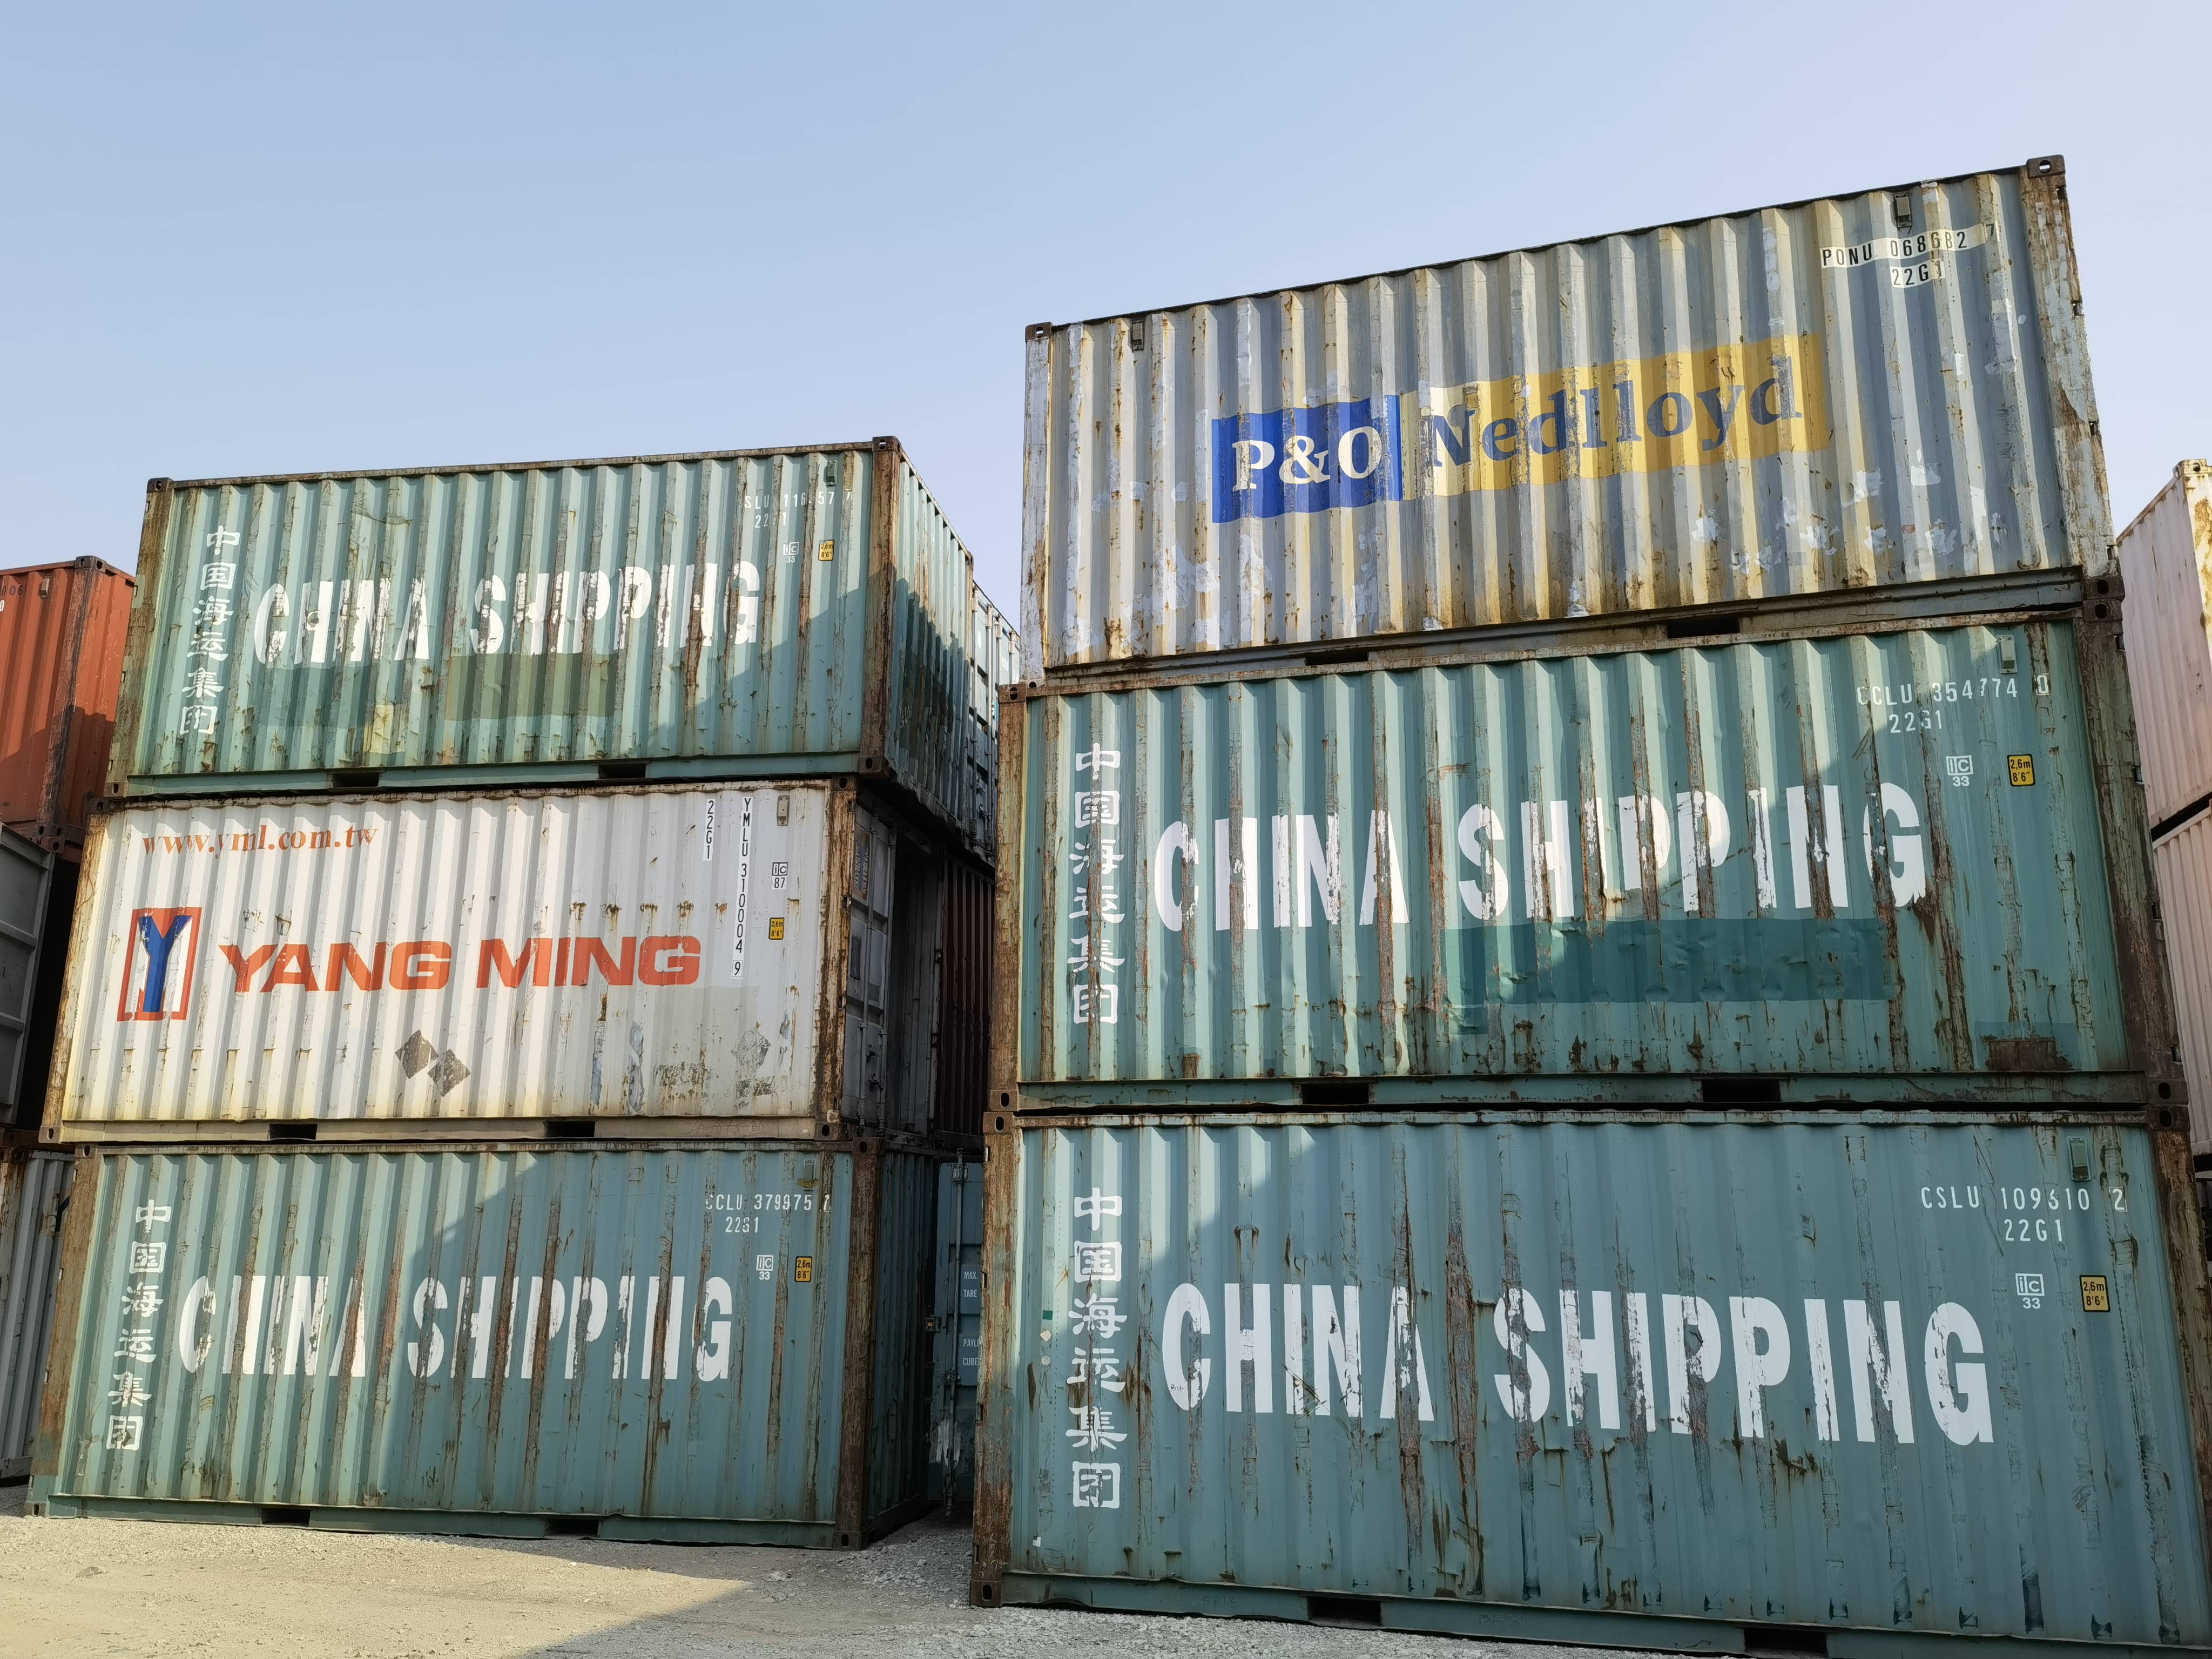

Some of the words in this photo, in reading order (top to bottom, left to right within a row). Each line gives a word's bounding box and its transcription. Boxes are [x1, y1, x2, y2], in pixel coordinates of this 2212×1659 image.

[1822, 243, 1872, 266] PONU
[1890, 231, 1967, 257] 068682
[1232, 424, 1382, 493] P&O
[1432, 355, 1803, 469] Nedlloyd
[254, 576, 431, 664] CHINA
[470, 559, 760, 655] SHIPPING
[1857, 683, 1913, 706] CCLU
[1932, 678, 2018, 703] 354774
[1889, 709, 1943, 734] 22G1
[2010, 759, 2031, 770] 2,6m
[1952, 775, 1970, 787] 33
[706, 800, 714, 860] 22G1
[741, 797, 751, 857] YMLU
[142, 825, 380, 860] www.yml.com.tw
[1154, 808, 1411, 932] CHINA
[1458, 782, 1927, 921] SHIPPING
[774, 877, 785, 888] 87
[735, 863, 748, 954] 310004
[218, 940, 452, 993] YANG
[476, 934, 702, 989] MING
[734, 961, 741, 976] 9
[753, 1193, 812, 1211] 379975
[1921, 1185, 1980, 1209] CSLU
[2000, 1187, 2090, 1210] 109610
[2112, 1188, 2125, 1211] 2
[2004, 1218, 2063, 1242] 22G1
[759, 1271, 770, 1280] 33
[964, 1271, 979, 1279] MAX.
[2083, 1281, 2105, 1293] 2,6m
[963, 1289, 977, 1298] TARE
[2022, 1297, 2041, 1309] 33
[178, 1274, 367, 1378] CHINA
[407, 1274, 733, 1382] SHIPPING
[1065, 1187, 1128, 1509] 中国海运集团
[1162, 1282, 1435, 1422] CHINA
[1493, 1287, 1994, 1447] SHIPPING
